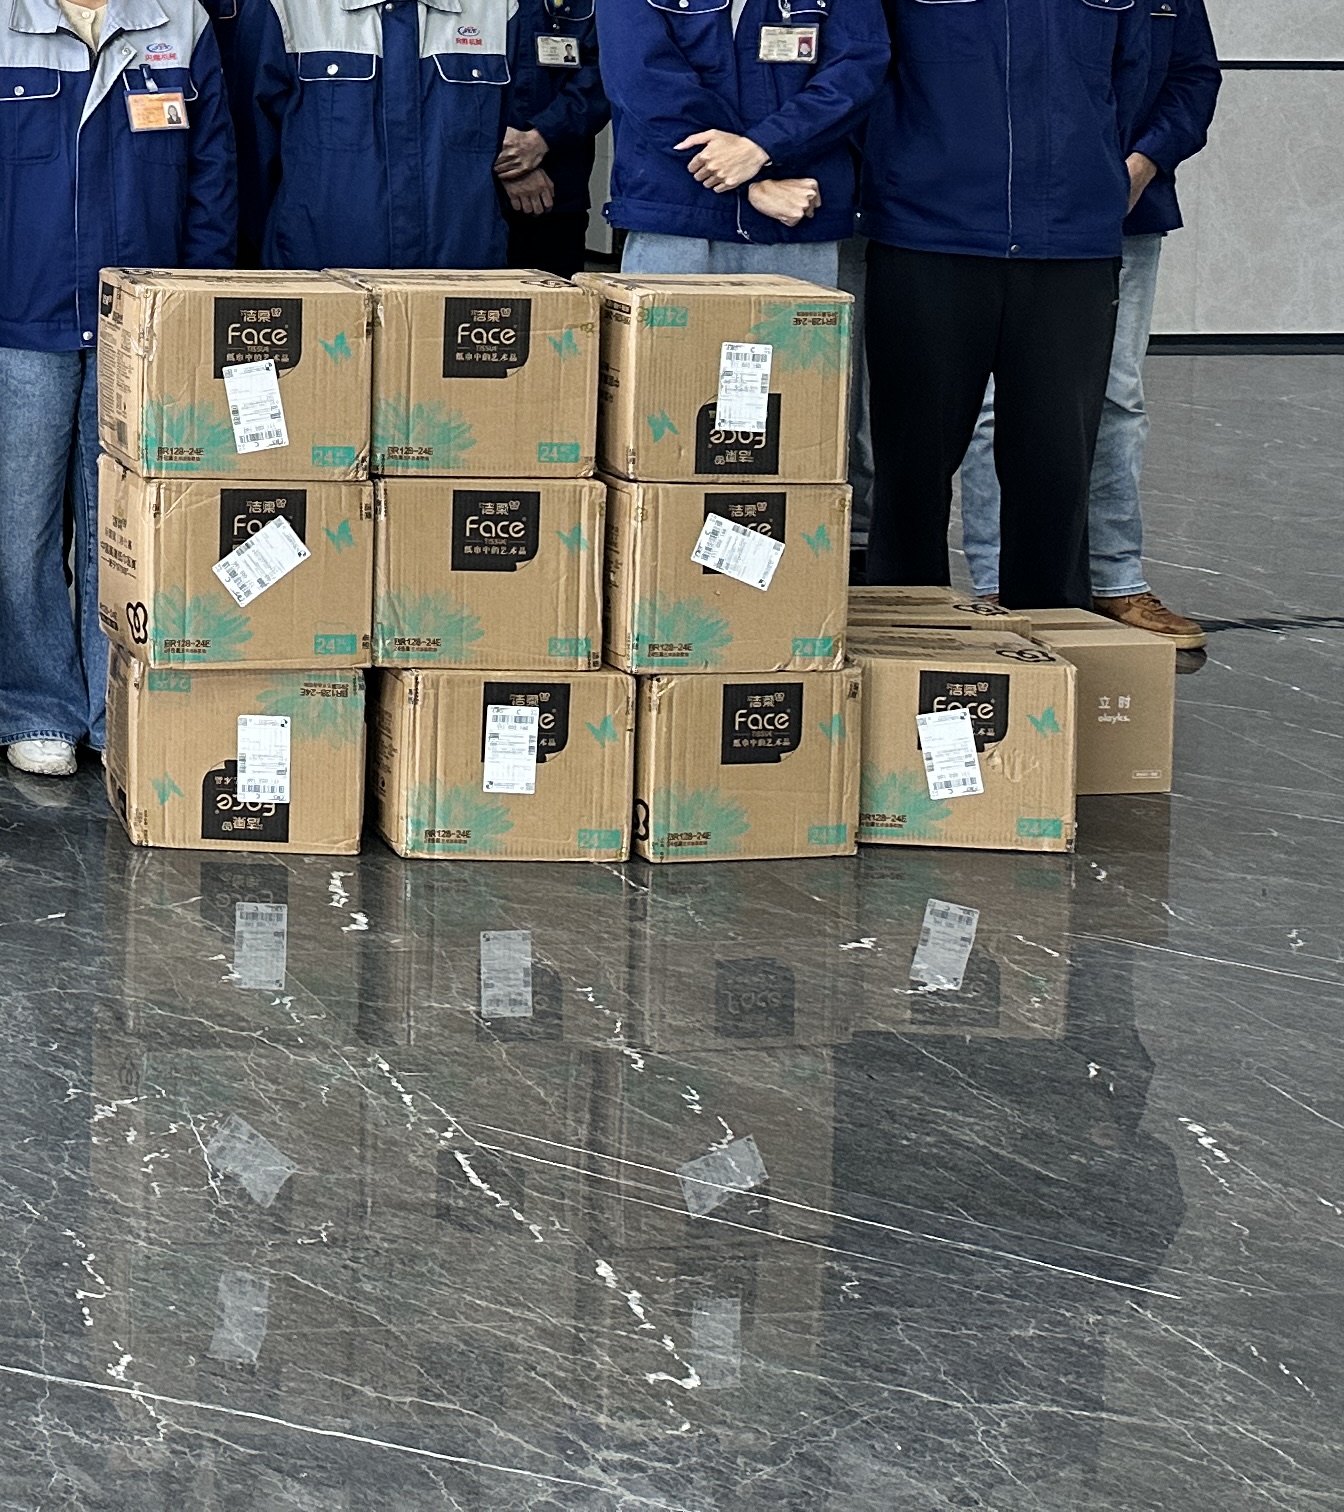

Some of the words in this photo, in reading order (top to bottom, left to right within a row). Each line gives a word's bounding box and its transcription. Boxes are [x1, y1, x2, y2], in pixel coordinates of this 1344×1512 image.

[227, 323, 288, 345] Face
[457, 323, 516, 345] Face
[465, 516, 525, 538] Face
[734, 709, 790, 731] Face
